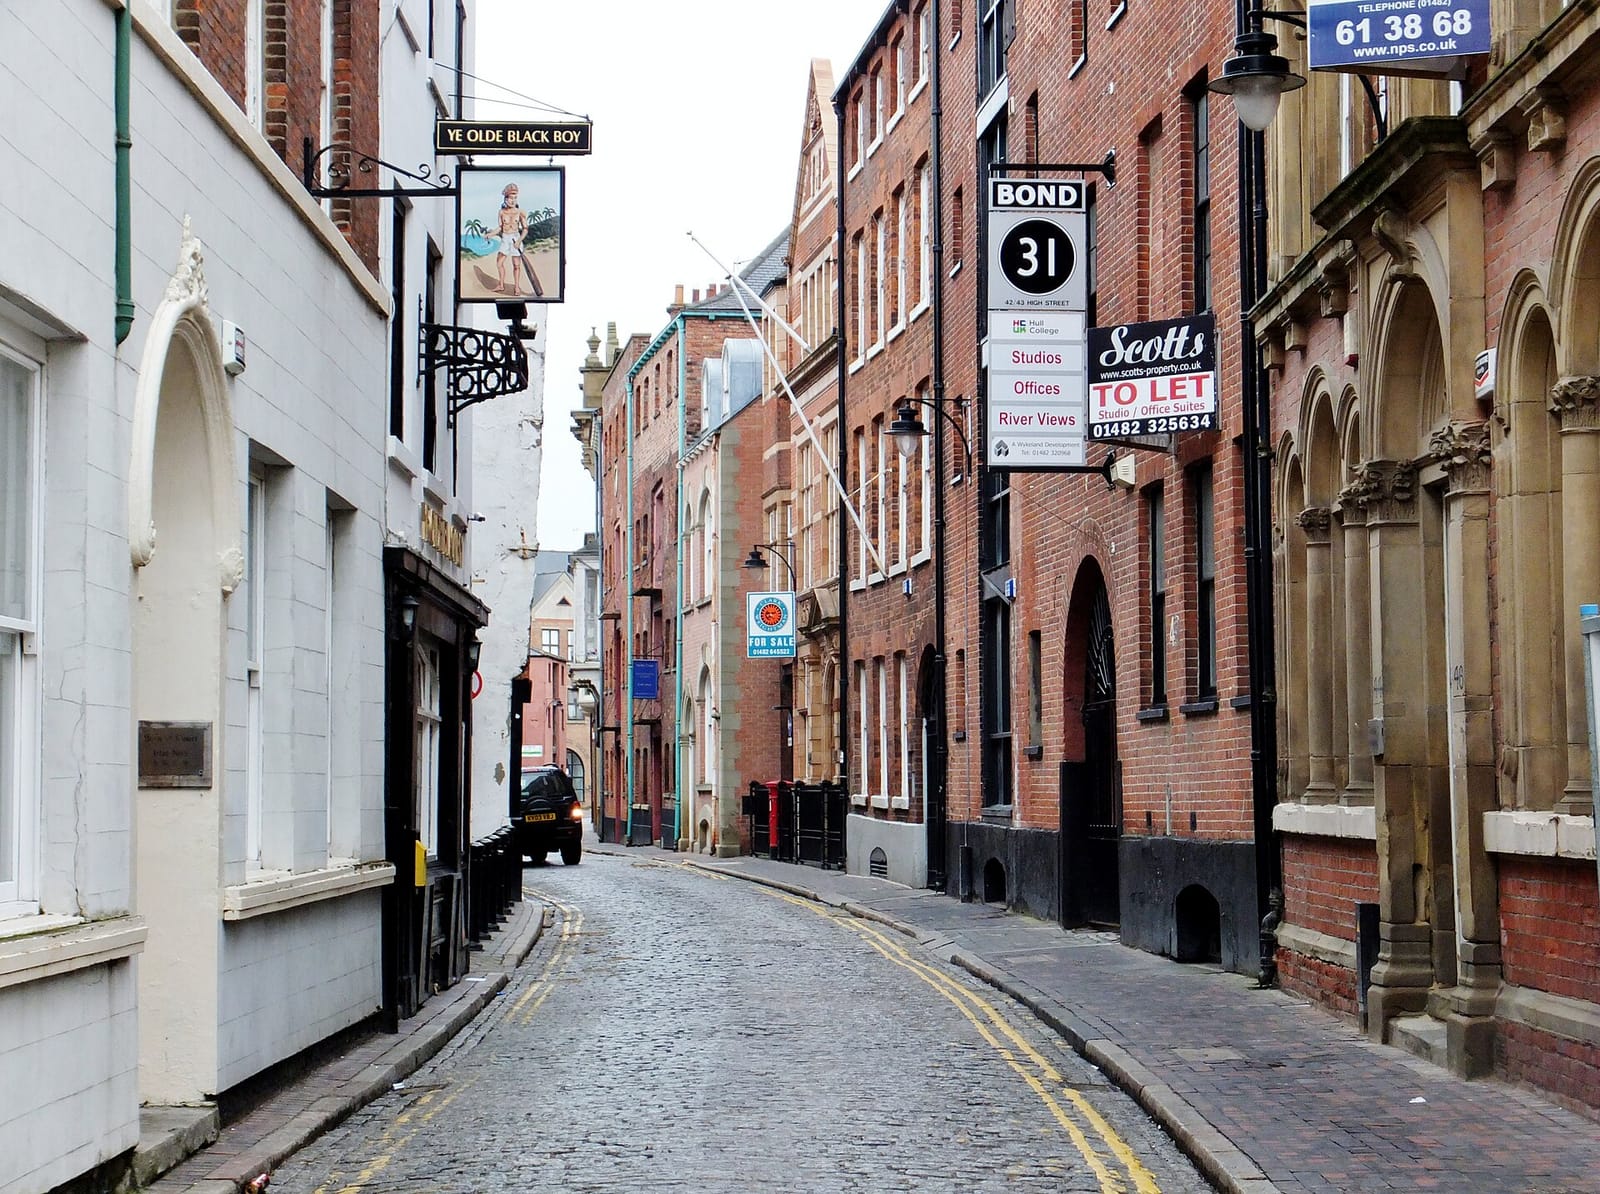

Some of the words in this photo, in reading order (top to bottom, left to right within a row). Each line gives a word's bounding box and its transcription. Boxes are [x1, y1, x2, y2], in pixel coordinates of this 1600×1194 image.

[1357, 1, 1416, 13] TELEPHONE
[1335, 18, 1371, 45] 61
[1384, 13, 1422, 41] 38
[1432, 9, 1472, 37] 68
[1353, 38, 1457, 57] www.nps.co.uk
[447, 129, 463, 142] YE
[466, 129, 503, 142] OLDE
[507, 130, 550, 143] BLACK
[553, 130, 581, 143] BOY
[997, 184, 1078, 206] BOND
[1017, 237, 1056, 277] 31
[1029, 327, 1060, 335] College
[1099, 325, 1205, 367] Scotts
[1012, 350, 1062, 364] Studios
[1100, 361, 1202, 380] www.scotts-property.co.uk
[1014, 381, 1061, 395] Offices
[1092, 382, 1138, 407] TO
[1150, 374, 1210, 402] LET
[999, 412, 1034, 425] River
[1037, 412, 1076, 426] Views
[1098, 408, 1130, 420] Studio
[1140, 404, 1171, 416] Office
[1173, 401, 1205, 413] Suites
[1093, 421, 1140, 438] 01482
[1147, 414, 1211, 432] 325634
[750, 637, 767, 647] FOR
[770, 637, 795, 647] SALE
